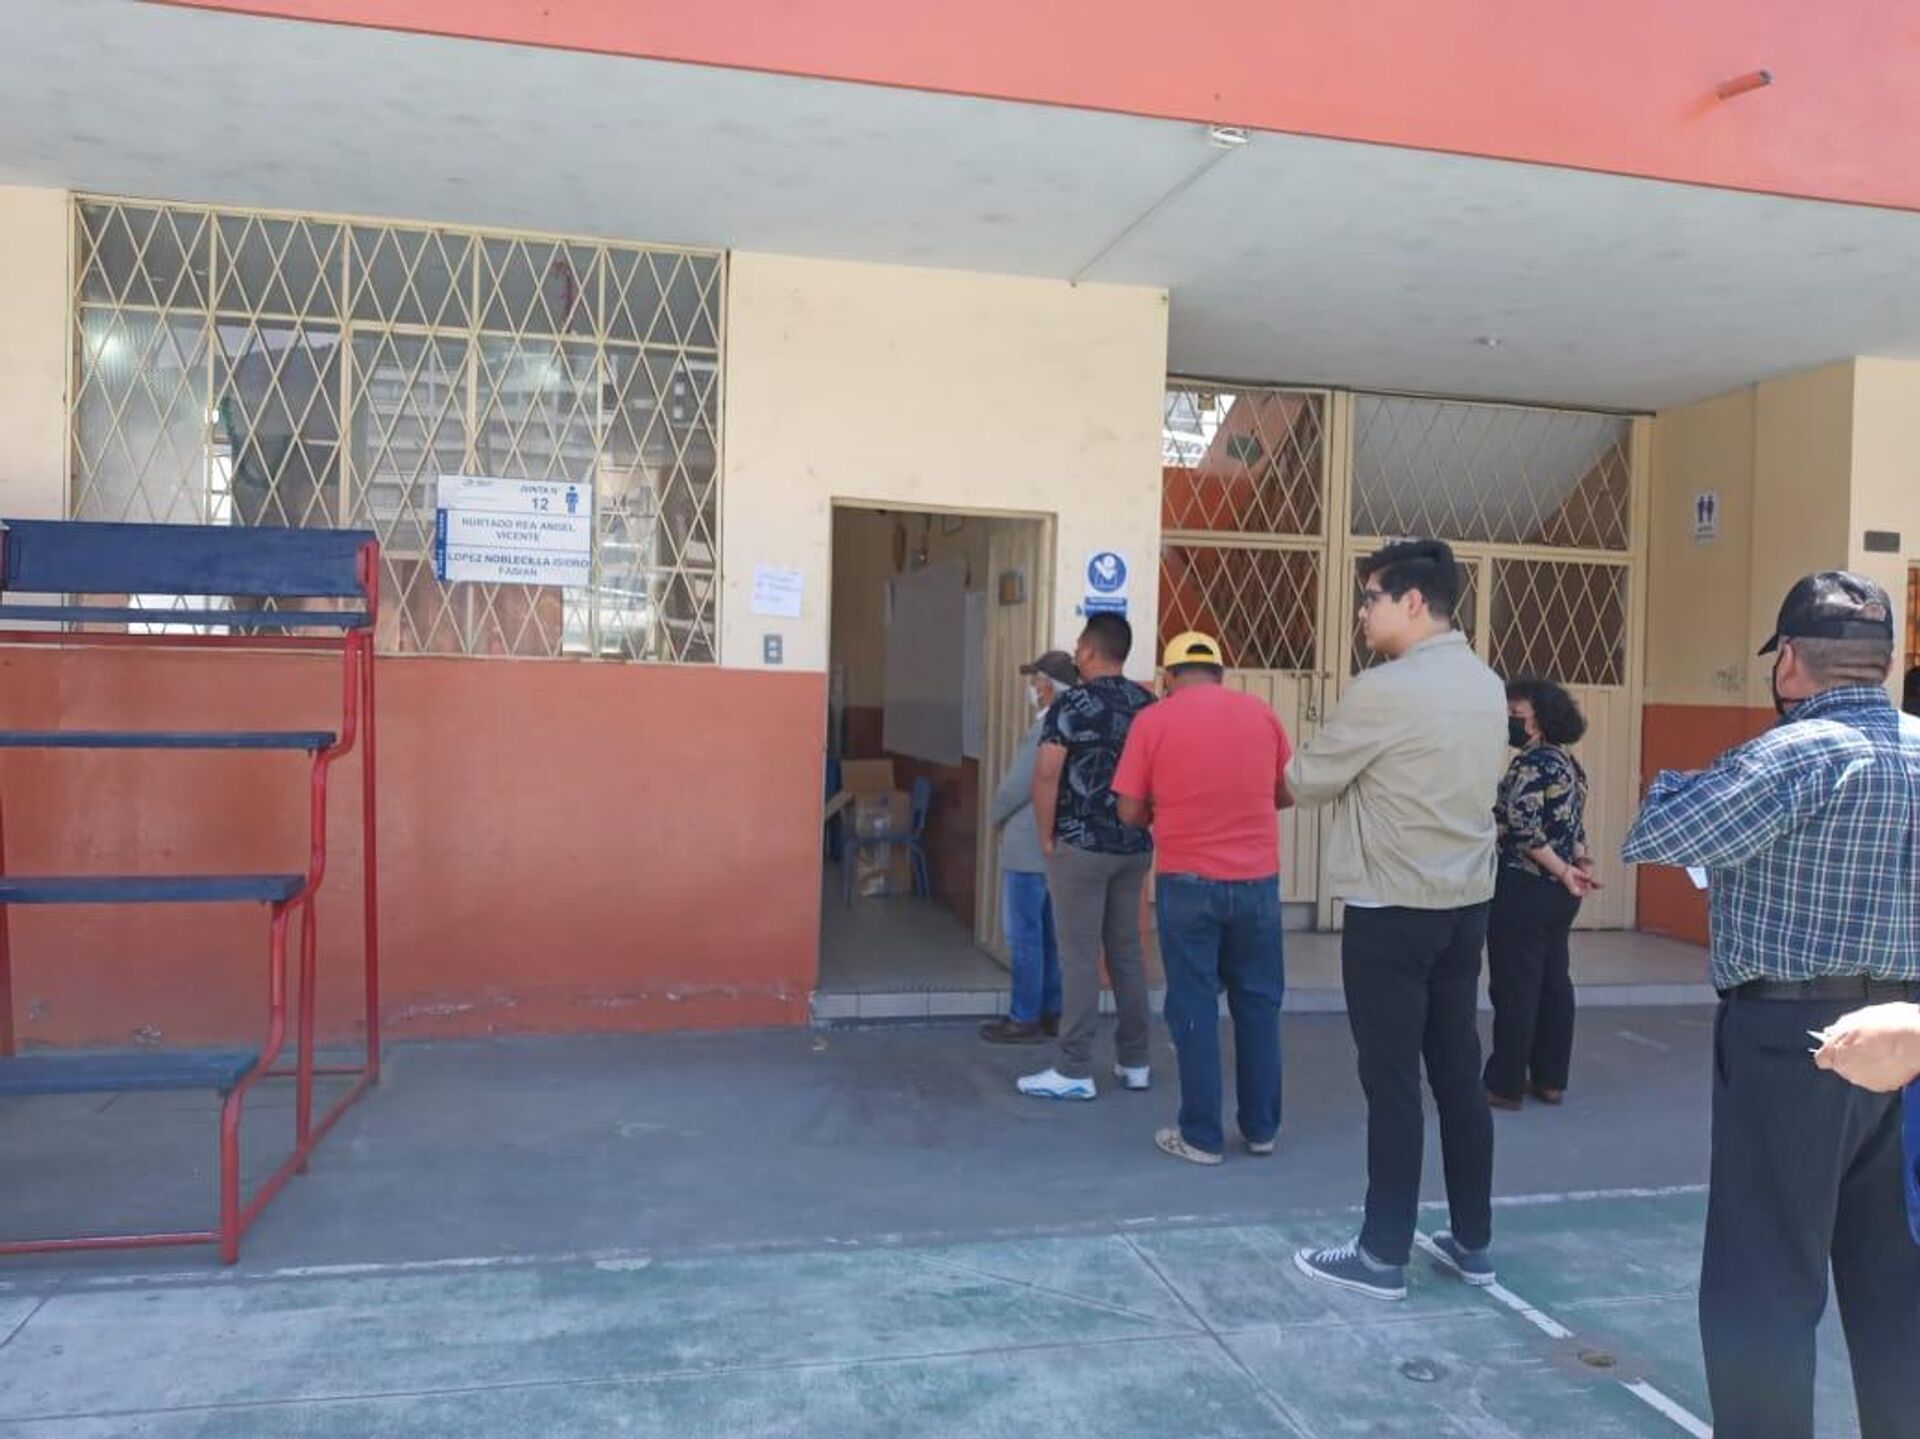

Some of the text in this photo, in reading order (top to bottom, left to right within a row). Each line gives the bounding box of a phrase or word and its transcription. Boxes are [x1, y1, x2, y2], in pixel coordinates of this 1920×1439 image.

[532, 497, 549, 511] 12
[462, 517, 576, 532] HURTADO REA ANGEL
[495, 531, 541, 542] VICENTE
[448, 552, 482, 563] LOPEZ
[484, 554, 550, 566] NOBLECILLA
[498, 566, 537, 576] FABIAN
